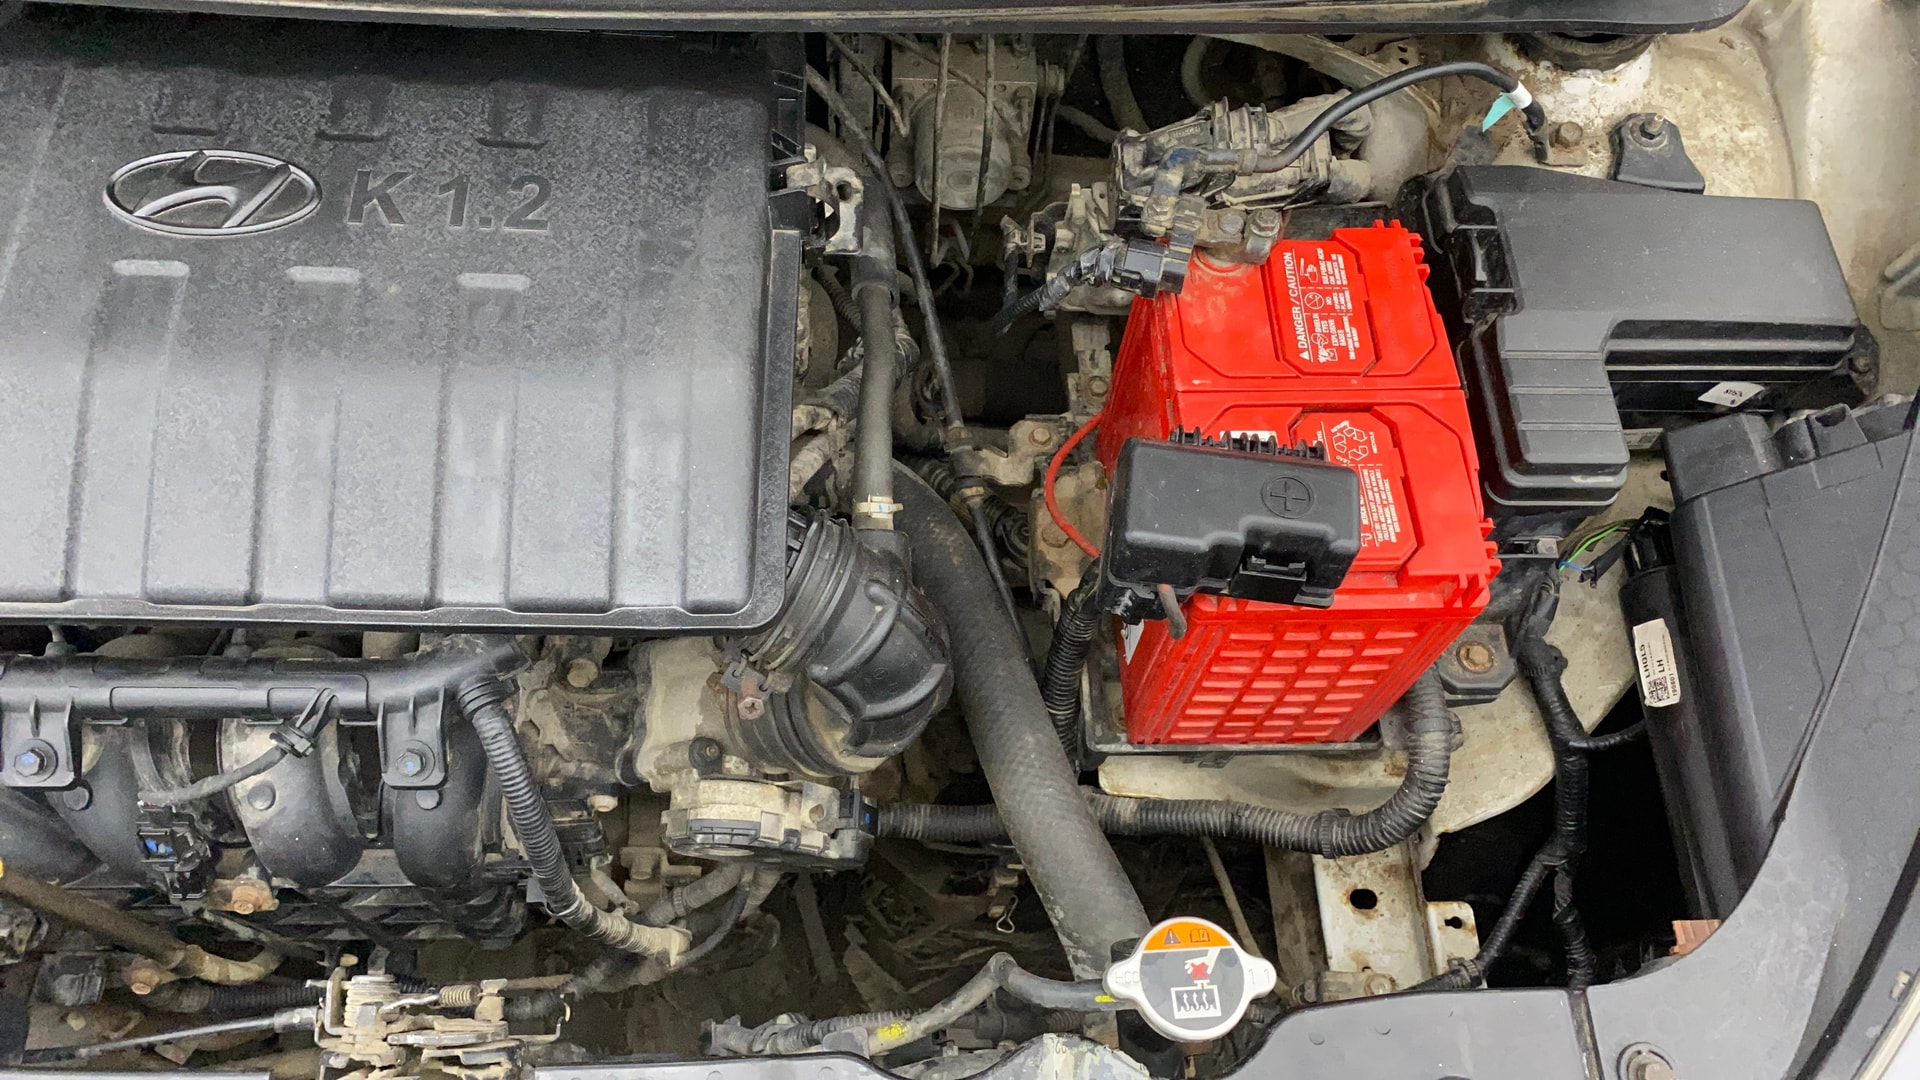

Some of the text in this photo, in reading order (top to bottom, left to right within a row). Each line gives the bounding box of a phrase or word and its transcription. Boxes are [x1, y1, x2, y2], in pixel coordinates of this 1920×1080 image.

[346, 168, 552, 231] K 1.2
[1283, 253, 1298, 296] CAUTION
[1292, 307, 1307, 348] DANGER
[1657, 659, 1665, 673] LH
